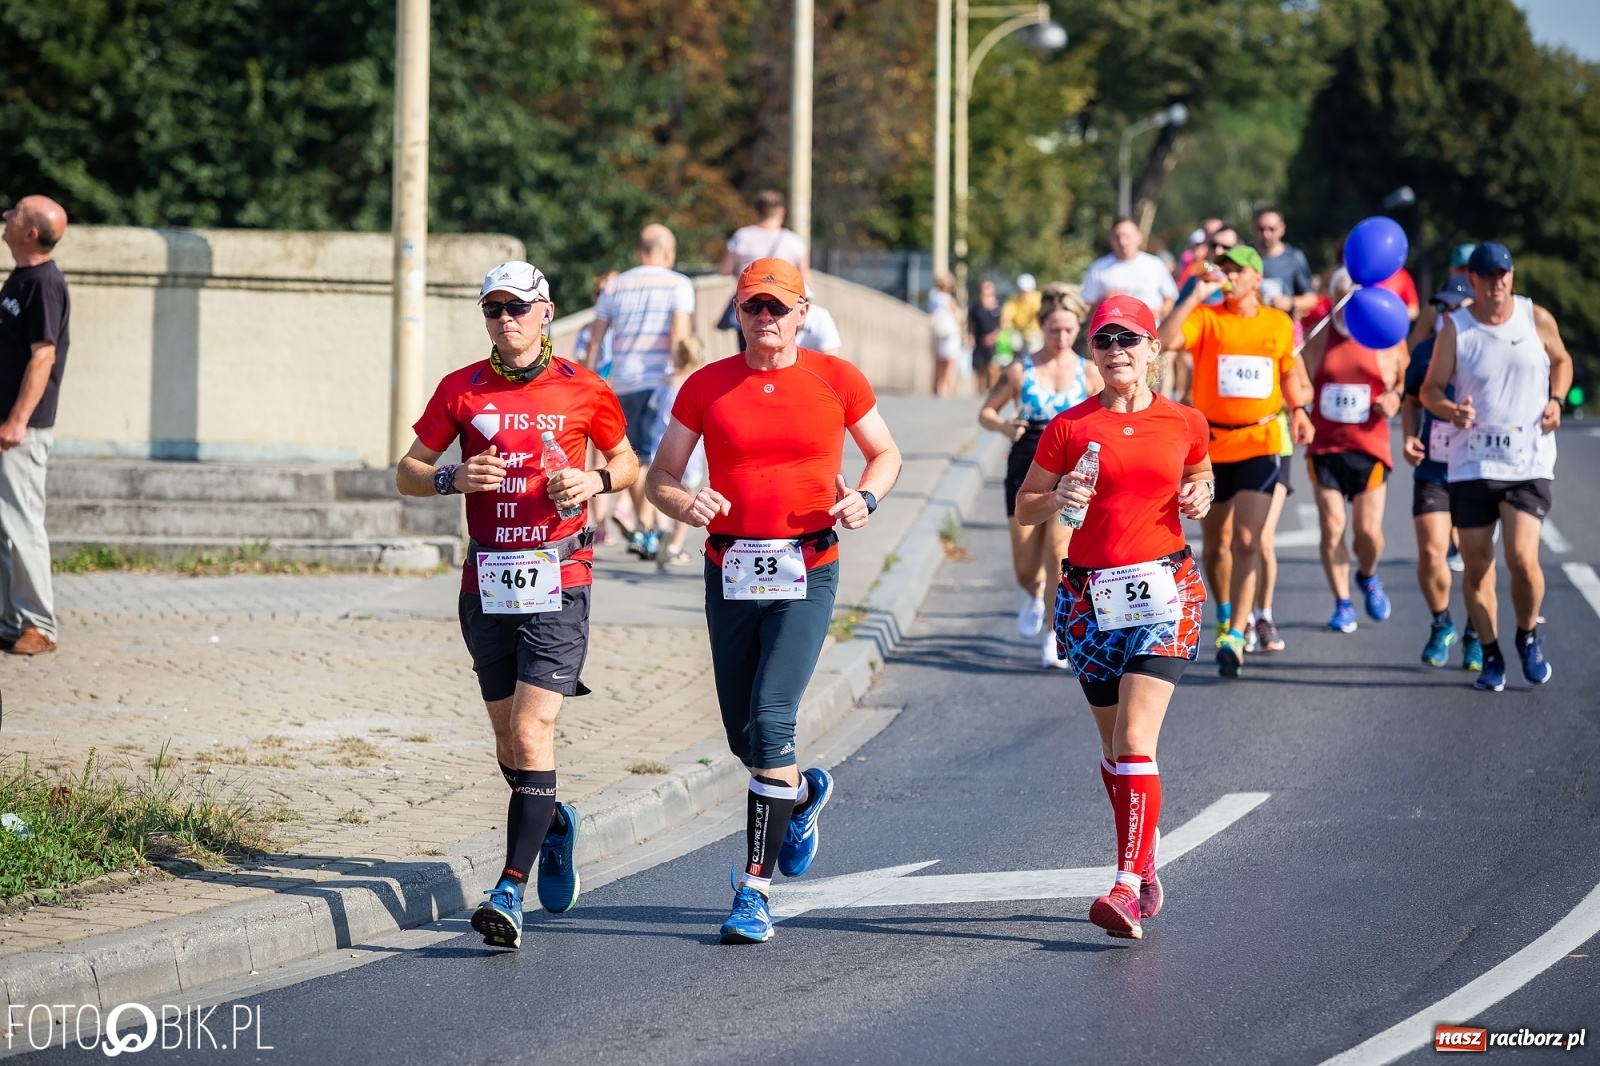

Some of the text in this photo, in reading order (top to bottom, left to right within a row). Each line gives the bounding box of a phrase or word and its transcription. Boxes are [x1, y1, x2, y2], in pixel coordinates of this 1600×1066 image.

[504, 413, 567, 431] FIS-SST
[496, 477, 527, 494] RUN
[496, 502, 517, 518] FIT
[495, 525, 549, 543] REPEAT
[754, 556, 778, 576] 53
[501, 568, 539, 590] 467
[1125, 580, 1151, 602] 52
